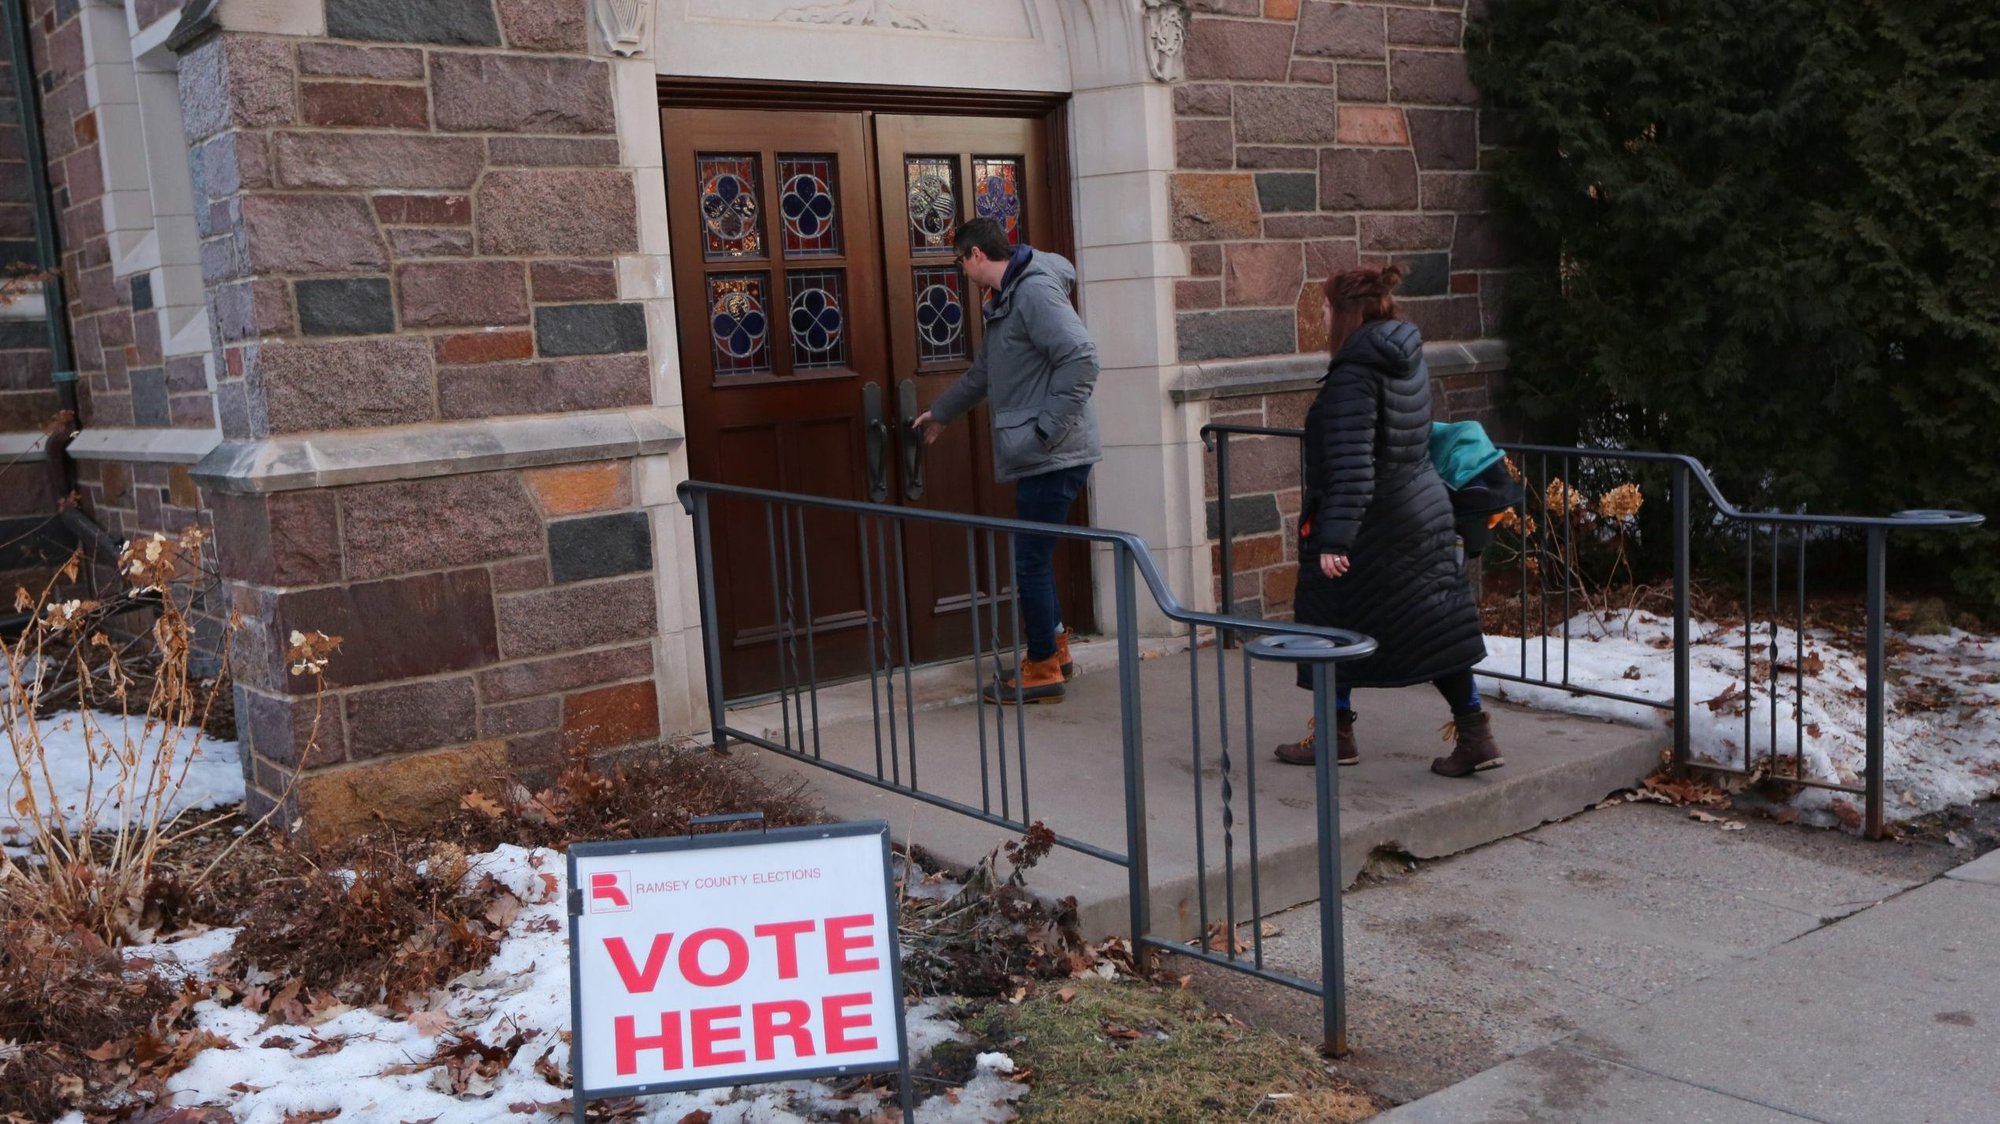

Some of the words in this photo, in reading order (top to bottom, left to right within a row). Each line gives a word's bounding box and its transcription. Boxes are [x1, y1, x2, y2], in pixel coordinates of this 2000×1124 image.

[636, 879, 690, 894] RAMSEY
[694, 874, 748, 890] COUNTY
[752, 867, 822, 885] ELECTIONS
[602, 913, 880, 994] VOTE
[614, 992, 878, 1076] HERE
